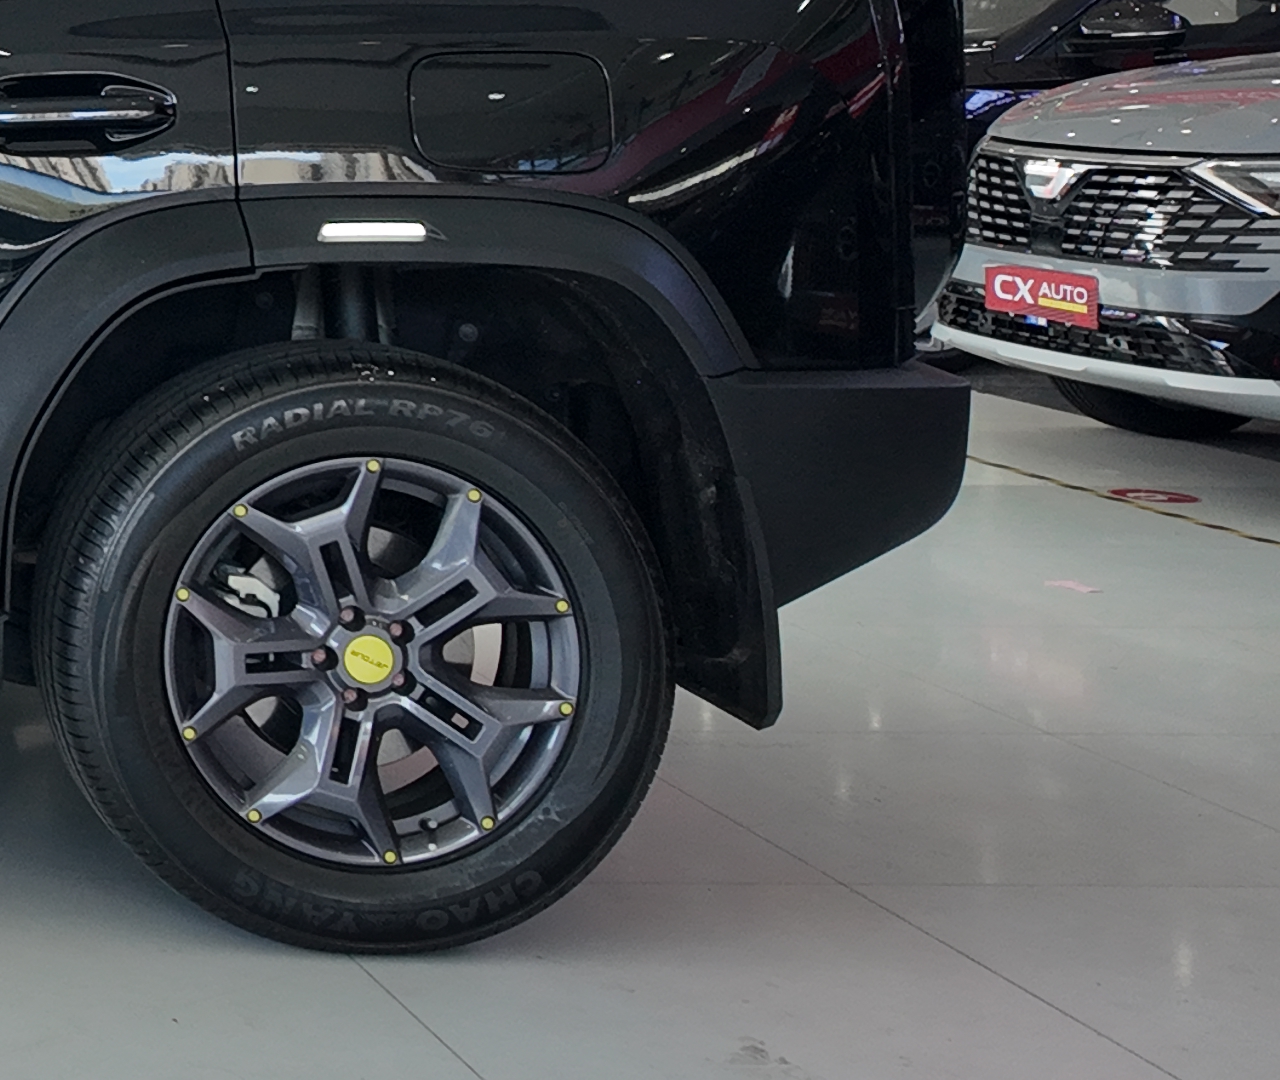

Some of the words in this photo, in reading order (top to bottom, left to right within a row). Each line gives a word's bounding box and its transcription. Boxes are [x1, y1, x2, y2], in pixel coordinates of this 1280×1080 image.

[994, 273, 1035, 305] CX
[1038, 281, 1088, 304] AUTO
[231, 398, 375, 452] RADIAL
